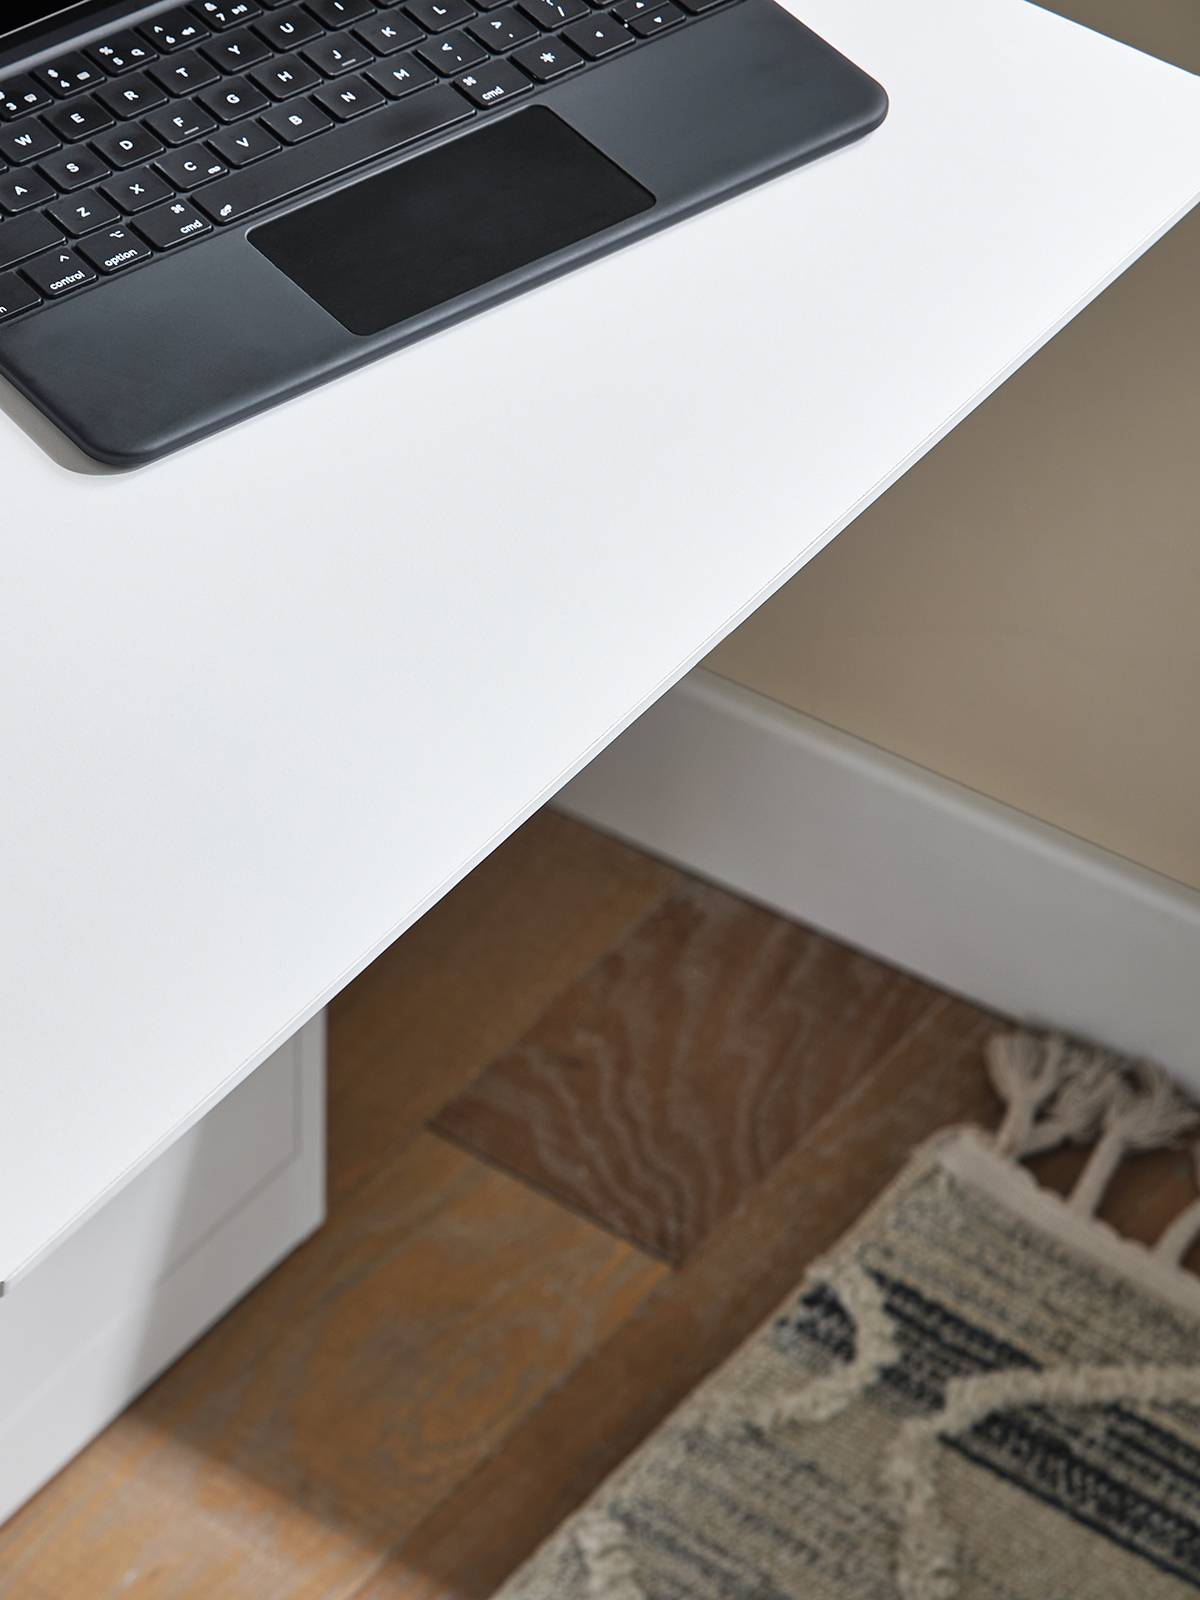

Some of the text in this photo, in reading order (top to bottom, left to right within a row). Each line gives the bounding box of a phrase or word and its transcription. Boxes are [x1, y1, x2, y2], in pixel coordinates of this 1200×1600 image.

[432, 6, 447, 15] L
[279, 22, 295, 34] U
[381, 26, 397, 38] K
[227, 44, 241, 55] Y
[332, 49, 342, 60] J
[175, 67, 189, 78] T
[277, 71, 293, 82] H
[392, 68, 410, 81] M
[123, 90, 139, 101] R
[340, 91, 357, 103] N
[481, 85, 505, 101] cmd
[226, 94, 240, 104] G
[5, 102, 17, 111] 3
[70, 113, 85, 124] E
[172, 116, 184, 128] F
[288, 115, 303, 126] B
[14, 134, 32, 146] W
[119, 140, 134, 151] D
[235, 137, 250, 148] V
[66, 163, 80, 173] S
[183, 161, 197, 172] C
[14, 185, 28, 196] A
[129, 183, 145, 195] X
[75, 206, 91, 218] Z
[180, 219, 203, 234] cmd
[104, 249, 138, 267] option
[49, 270, 86, 290] control
